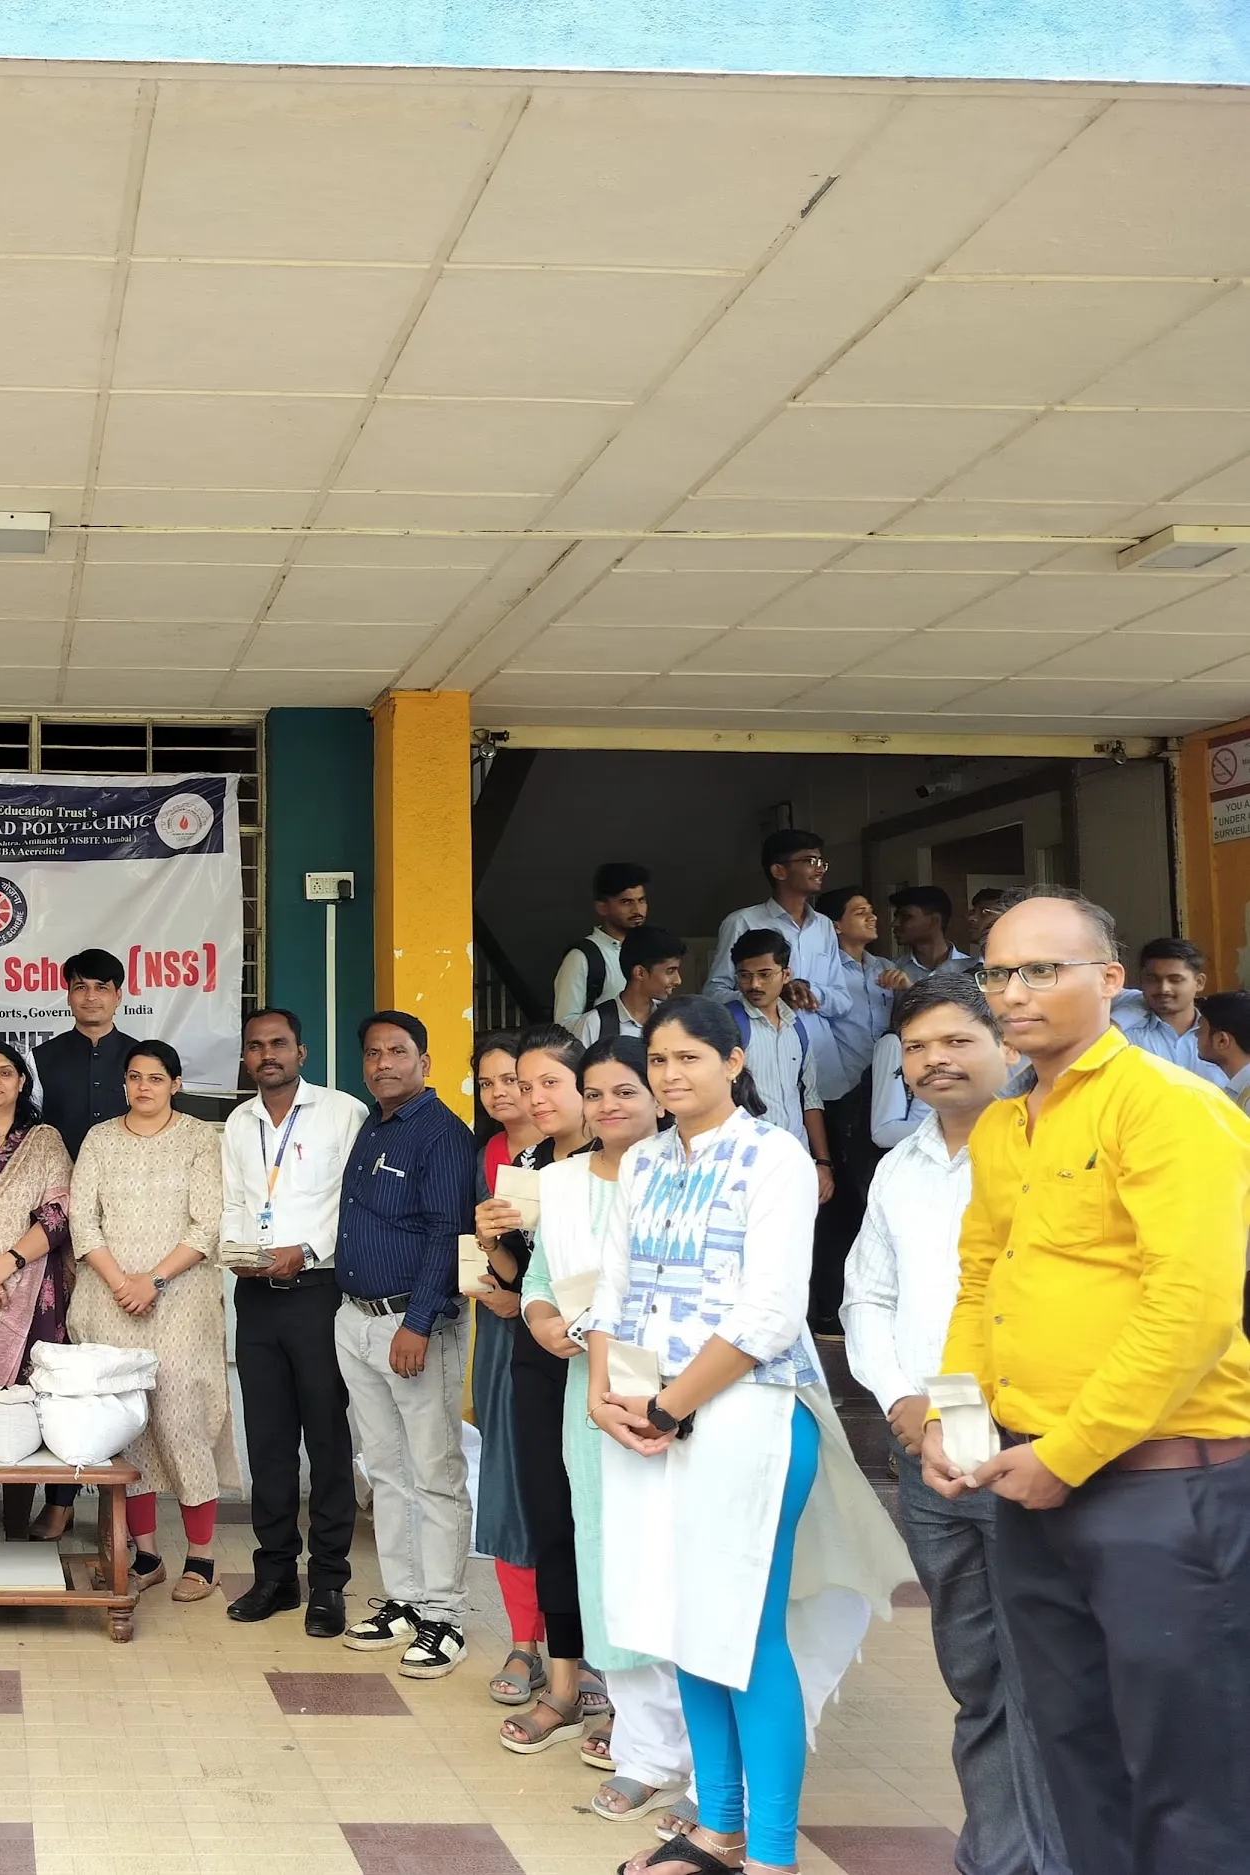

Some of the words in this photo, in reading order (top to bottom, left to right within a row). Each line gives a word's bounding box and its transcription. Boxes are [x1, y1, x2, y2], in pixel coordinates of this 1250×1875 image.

[1226, 802, 1243, 812] YOU
[1244, 800, 1250, 810] A
[22, 814, 153, 835] POLYTECHNIC
[1218, 813, 1246, 827] UNDER
[1214, 824, 1250, 840] SURVEILL
[58, 836, 68, 845] To
[70, 836, 100, 845] MSBTE
[17, 847, 65, 856] Accredited
[6, 910, 25, 938] SCHEME
[4, 956, 68, 993] Sch
[28, 1006, 74, 1019] Govern
[124, 1004, 153, 1015] India
